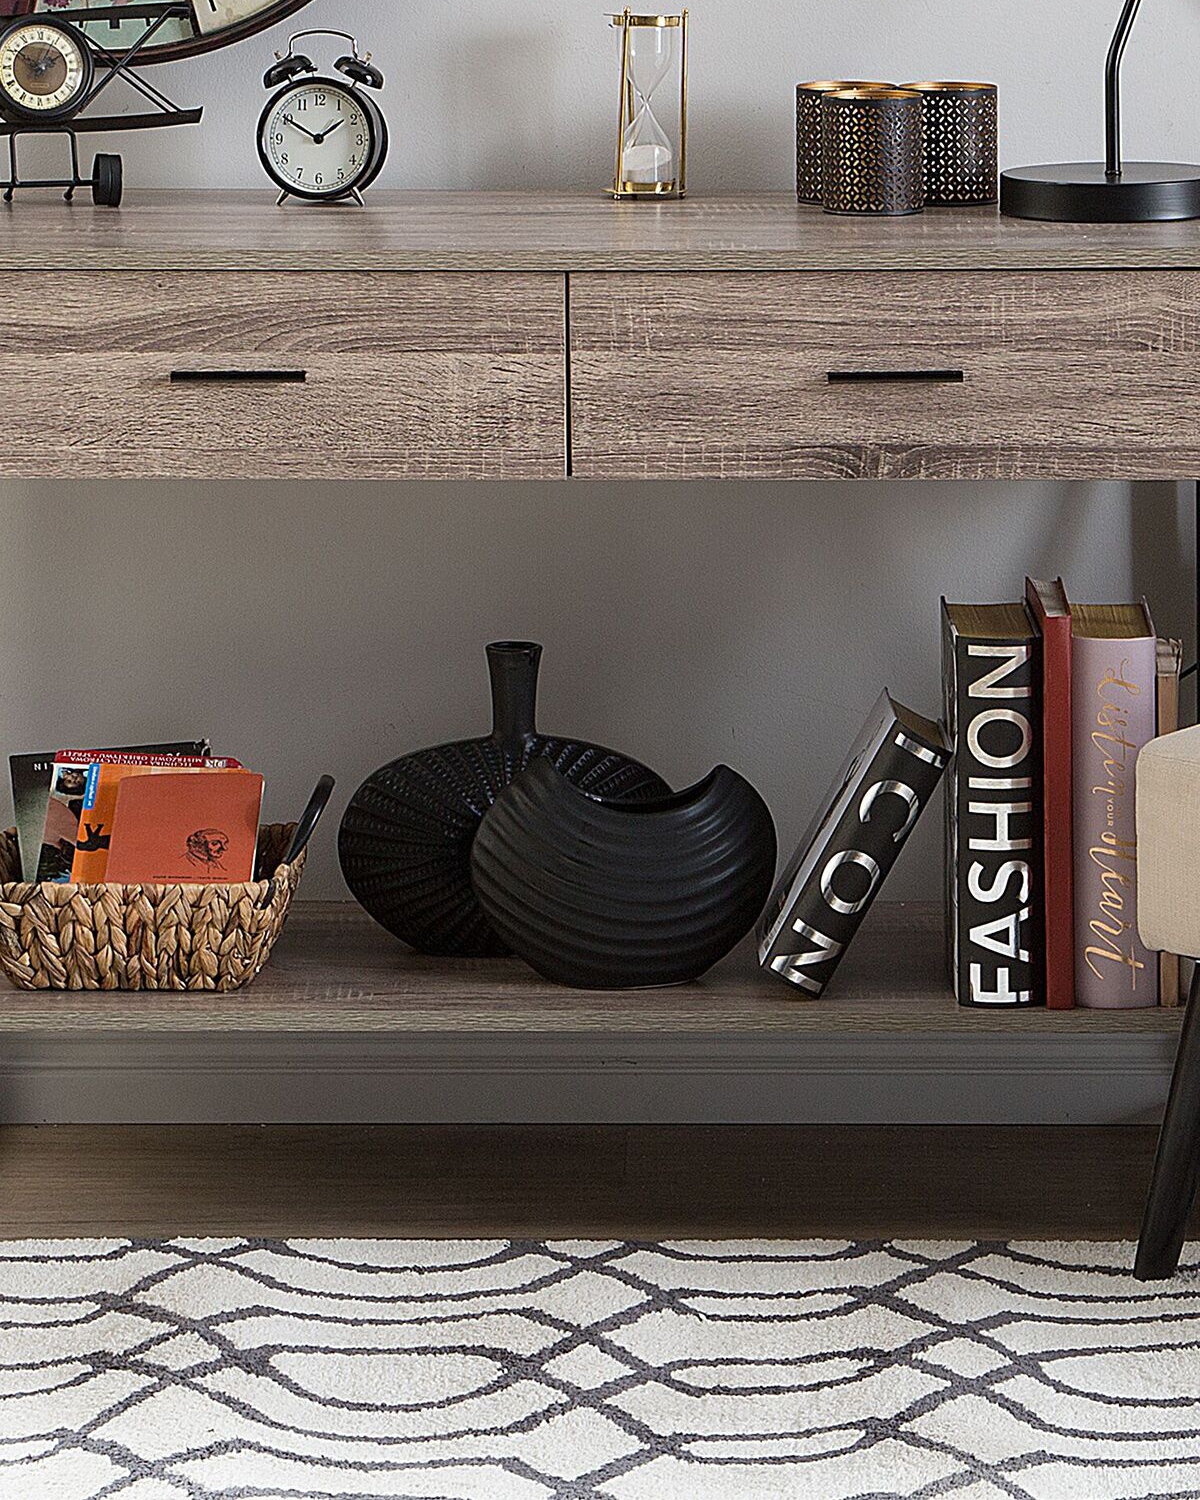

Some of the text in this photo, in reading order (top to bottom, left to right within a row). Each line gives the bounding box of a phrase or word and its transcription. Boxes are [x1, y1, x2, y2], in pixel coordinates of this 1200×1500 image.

[297, 99, 307, 111] 11
[314, 94, 326, 106] 12
[337, 99, 341, 111] 1
[282, 113, 294, 125] 10
[350, 114, 357, 125] 2
[275, 133, 283, 145] 9
[356, 134, 363, 146] 3
[281, 153, 288, 165] 8
[349, 154, 356, 165] 4
[296, 168, 303, 179] 7
[315, 172, 322, 184] 6
[337, 168, 344, 180] 5
[1092, 658, 1141, 794] Listen
[1106, 797, 1114, 827] YOUR
[967, 645, 1032, 1003] FASHION
[770, 732, 946, 994] ICON
